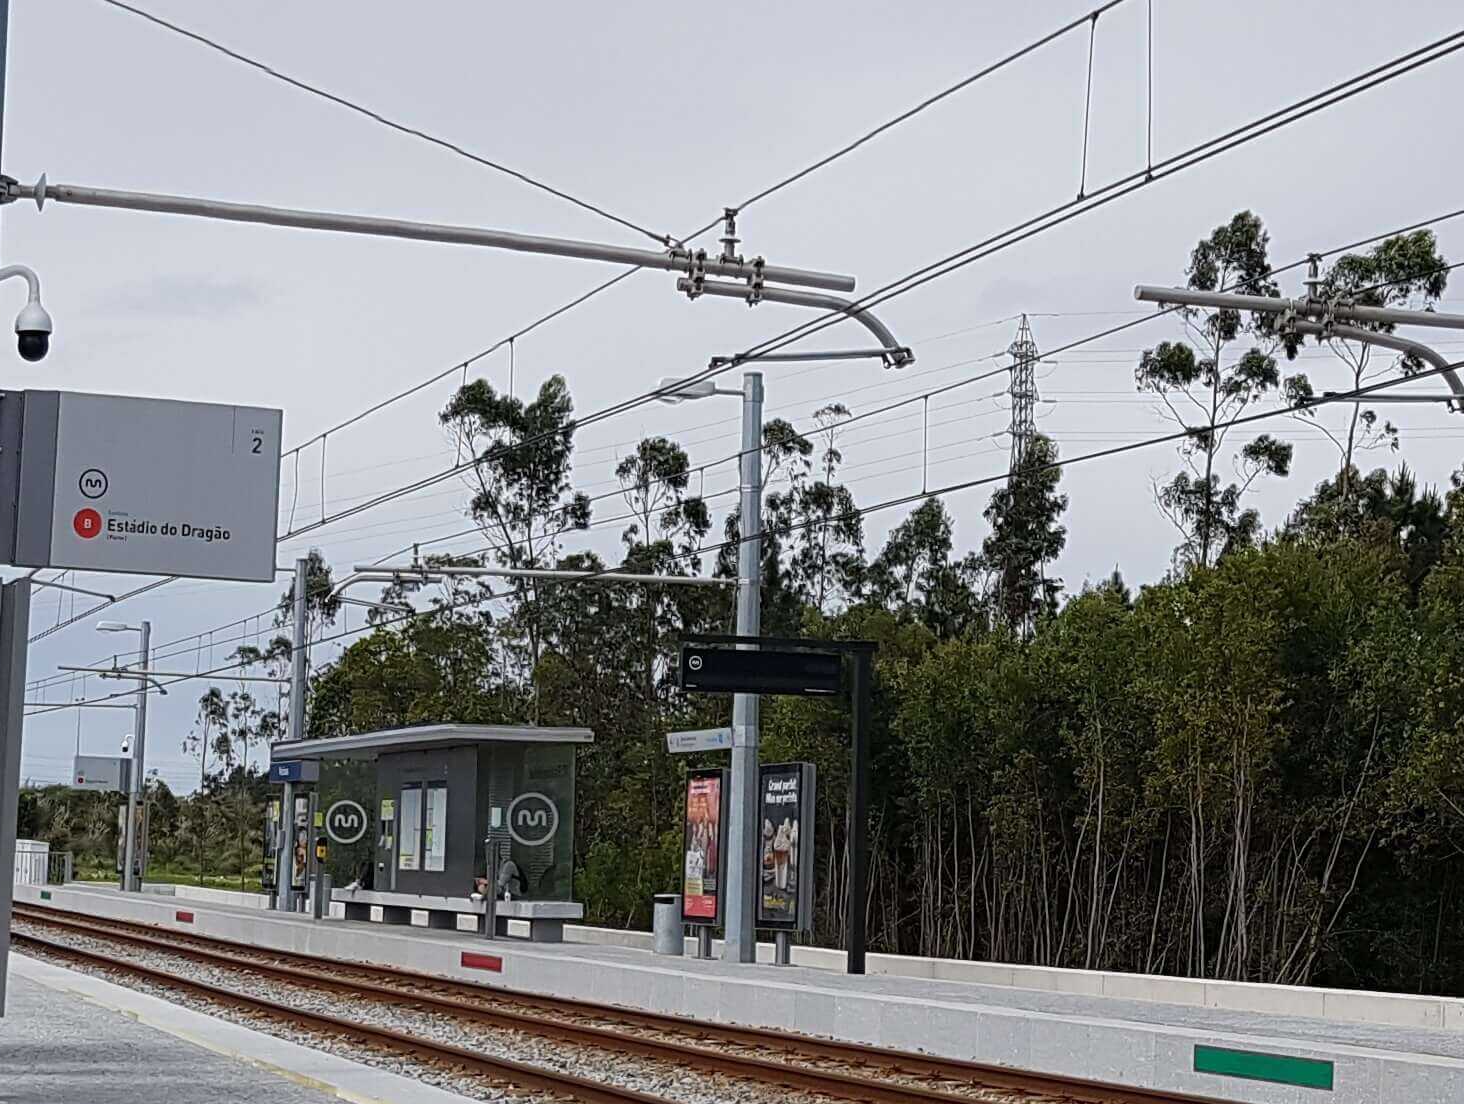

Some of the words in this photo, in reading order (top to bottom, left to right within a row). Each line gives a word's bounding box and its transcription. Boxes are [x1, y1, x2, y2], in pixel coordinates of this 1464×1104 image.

[251, 437, 262, 454] 2
[84, 518, 92, 529] B
[107, 518, 157, 534] Estádio
[160, 523, 178, 536] do
[181, 523, 231, 542] Dragão
